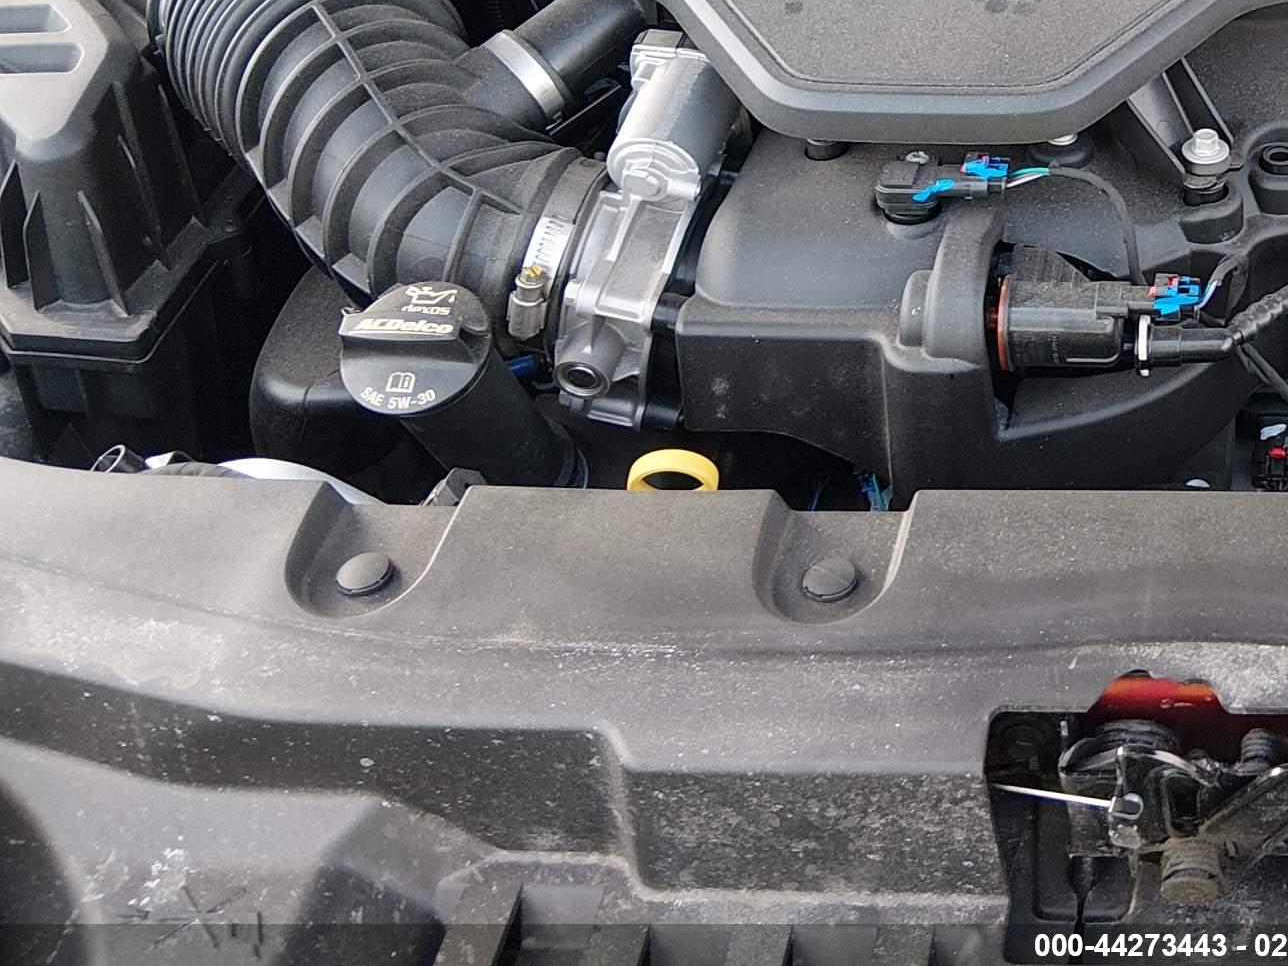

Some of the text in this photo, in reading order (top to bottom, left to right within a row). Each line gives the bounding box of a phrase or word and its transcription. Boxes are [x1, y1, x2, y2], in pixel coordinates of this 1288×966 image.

[353, 318, 454, 334] ACDelco
[360, 386, 436, 410] SAE 5W-30
